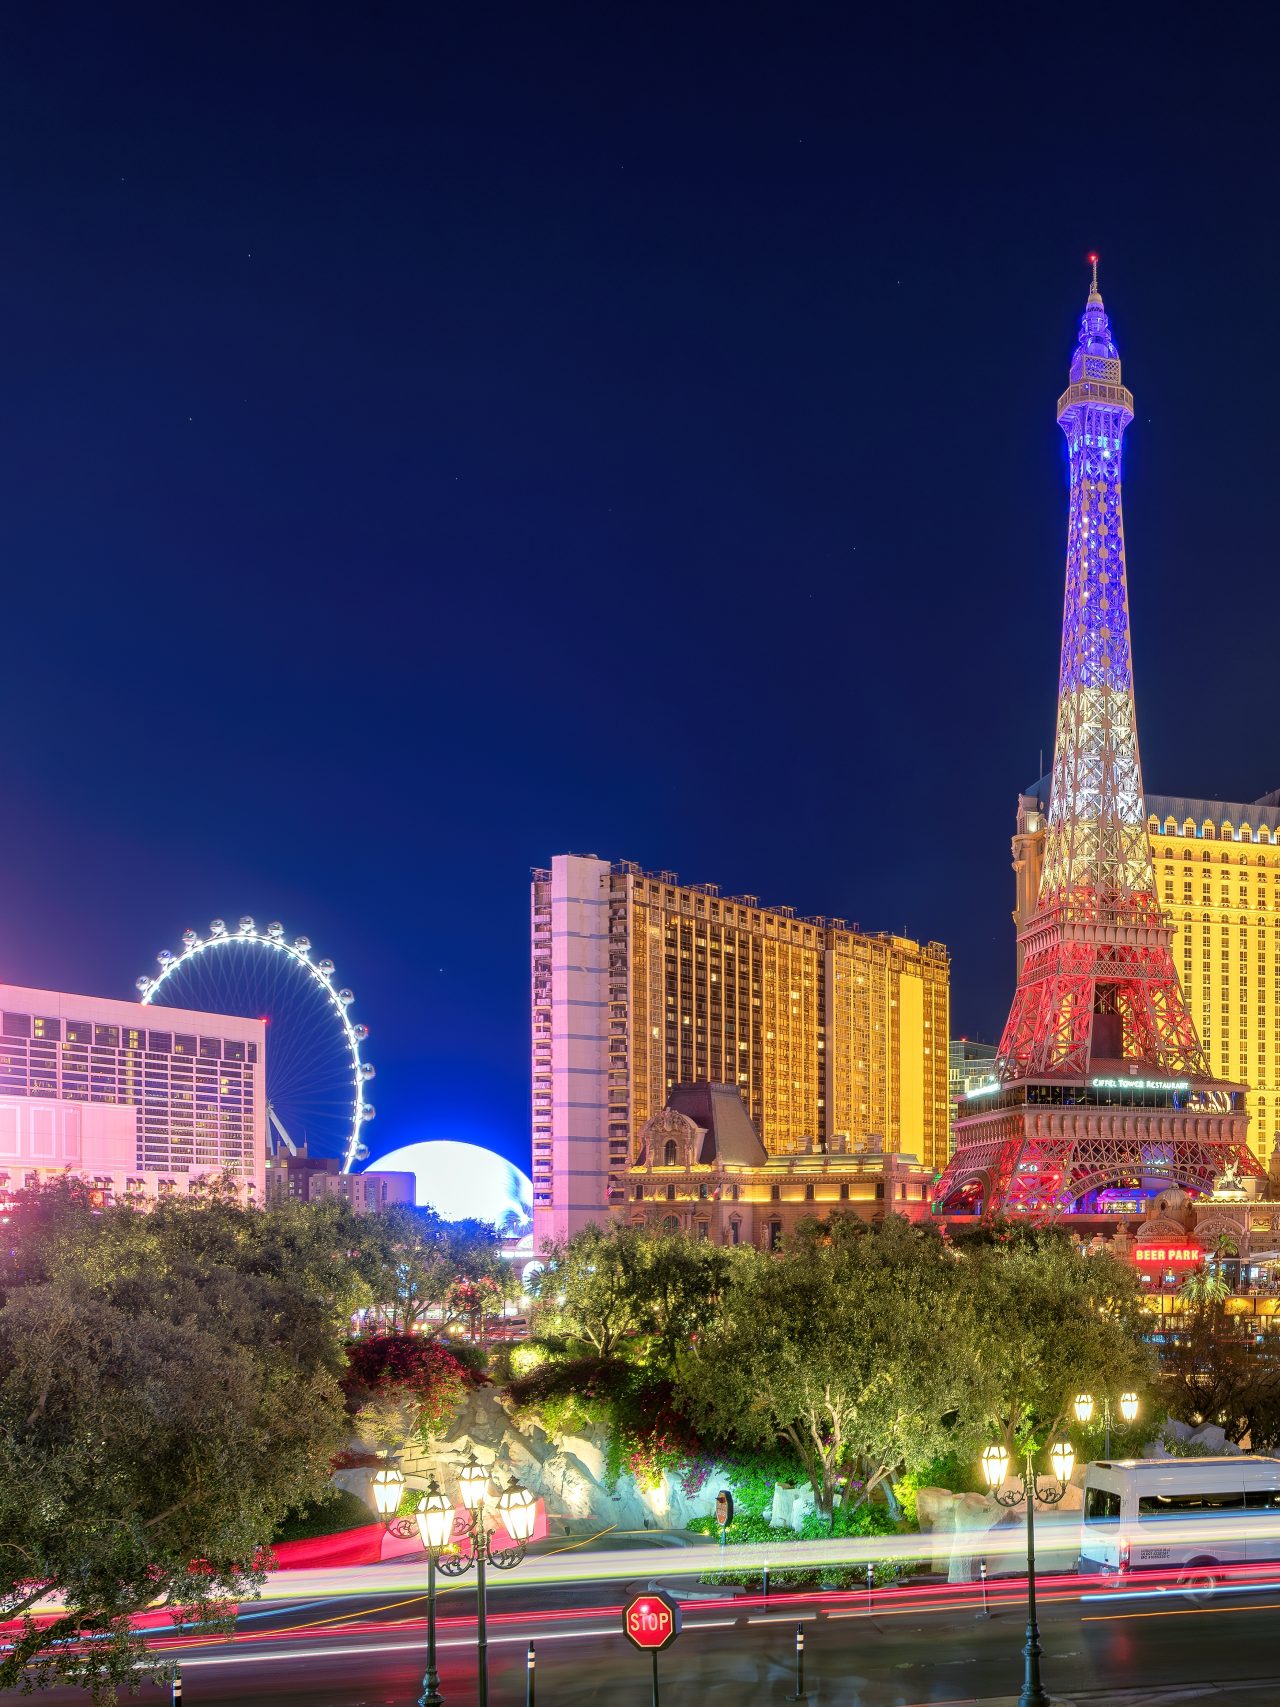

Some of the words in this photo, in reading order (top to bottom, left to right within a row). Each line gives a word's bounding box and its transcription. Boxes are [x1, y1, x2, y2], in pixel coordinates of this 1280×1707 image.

[1092, 1079, 1117, 1088] EIFFEL
[1119, 1080, 1144, 1088] TOWER
[1146, 1081, 1189, 1090] RESTAURANT
[1136, 1250, 1166, 1260] BEER
[1168, 1250, 1199, 1260] PARK
[631, 1612, 669, 1632] STOP
